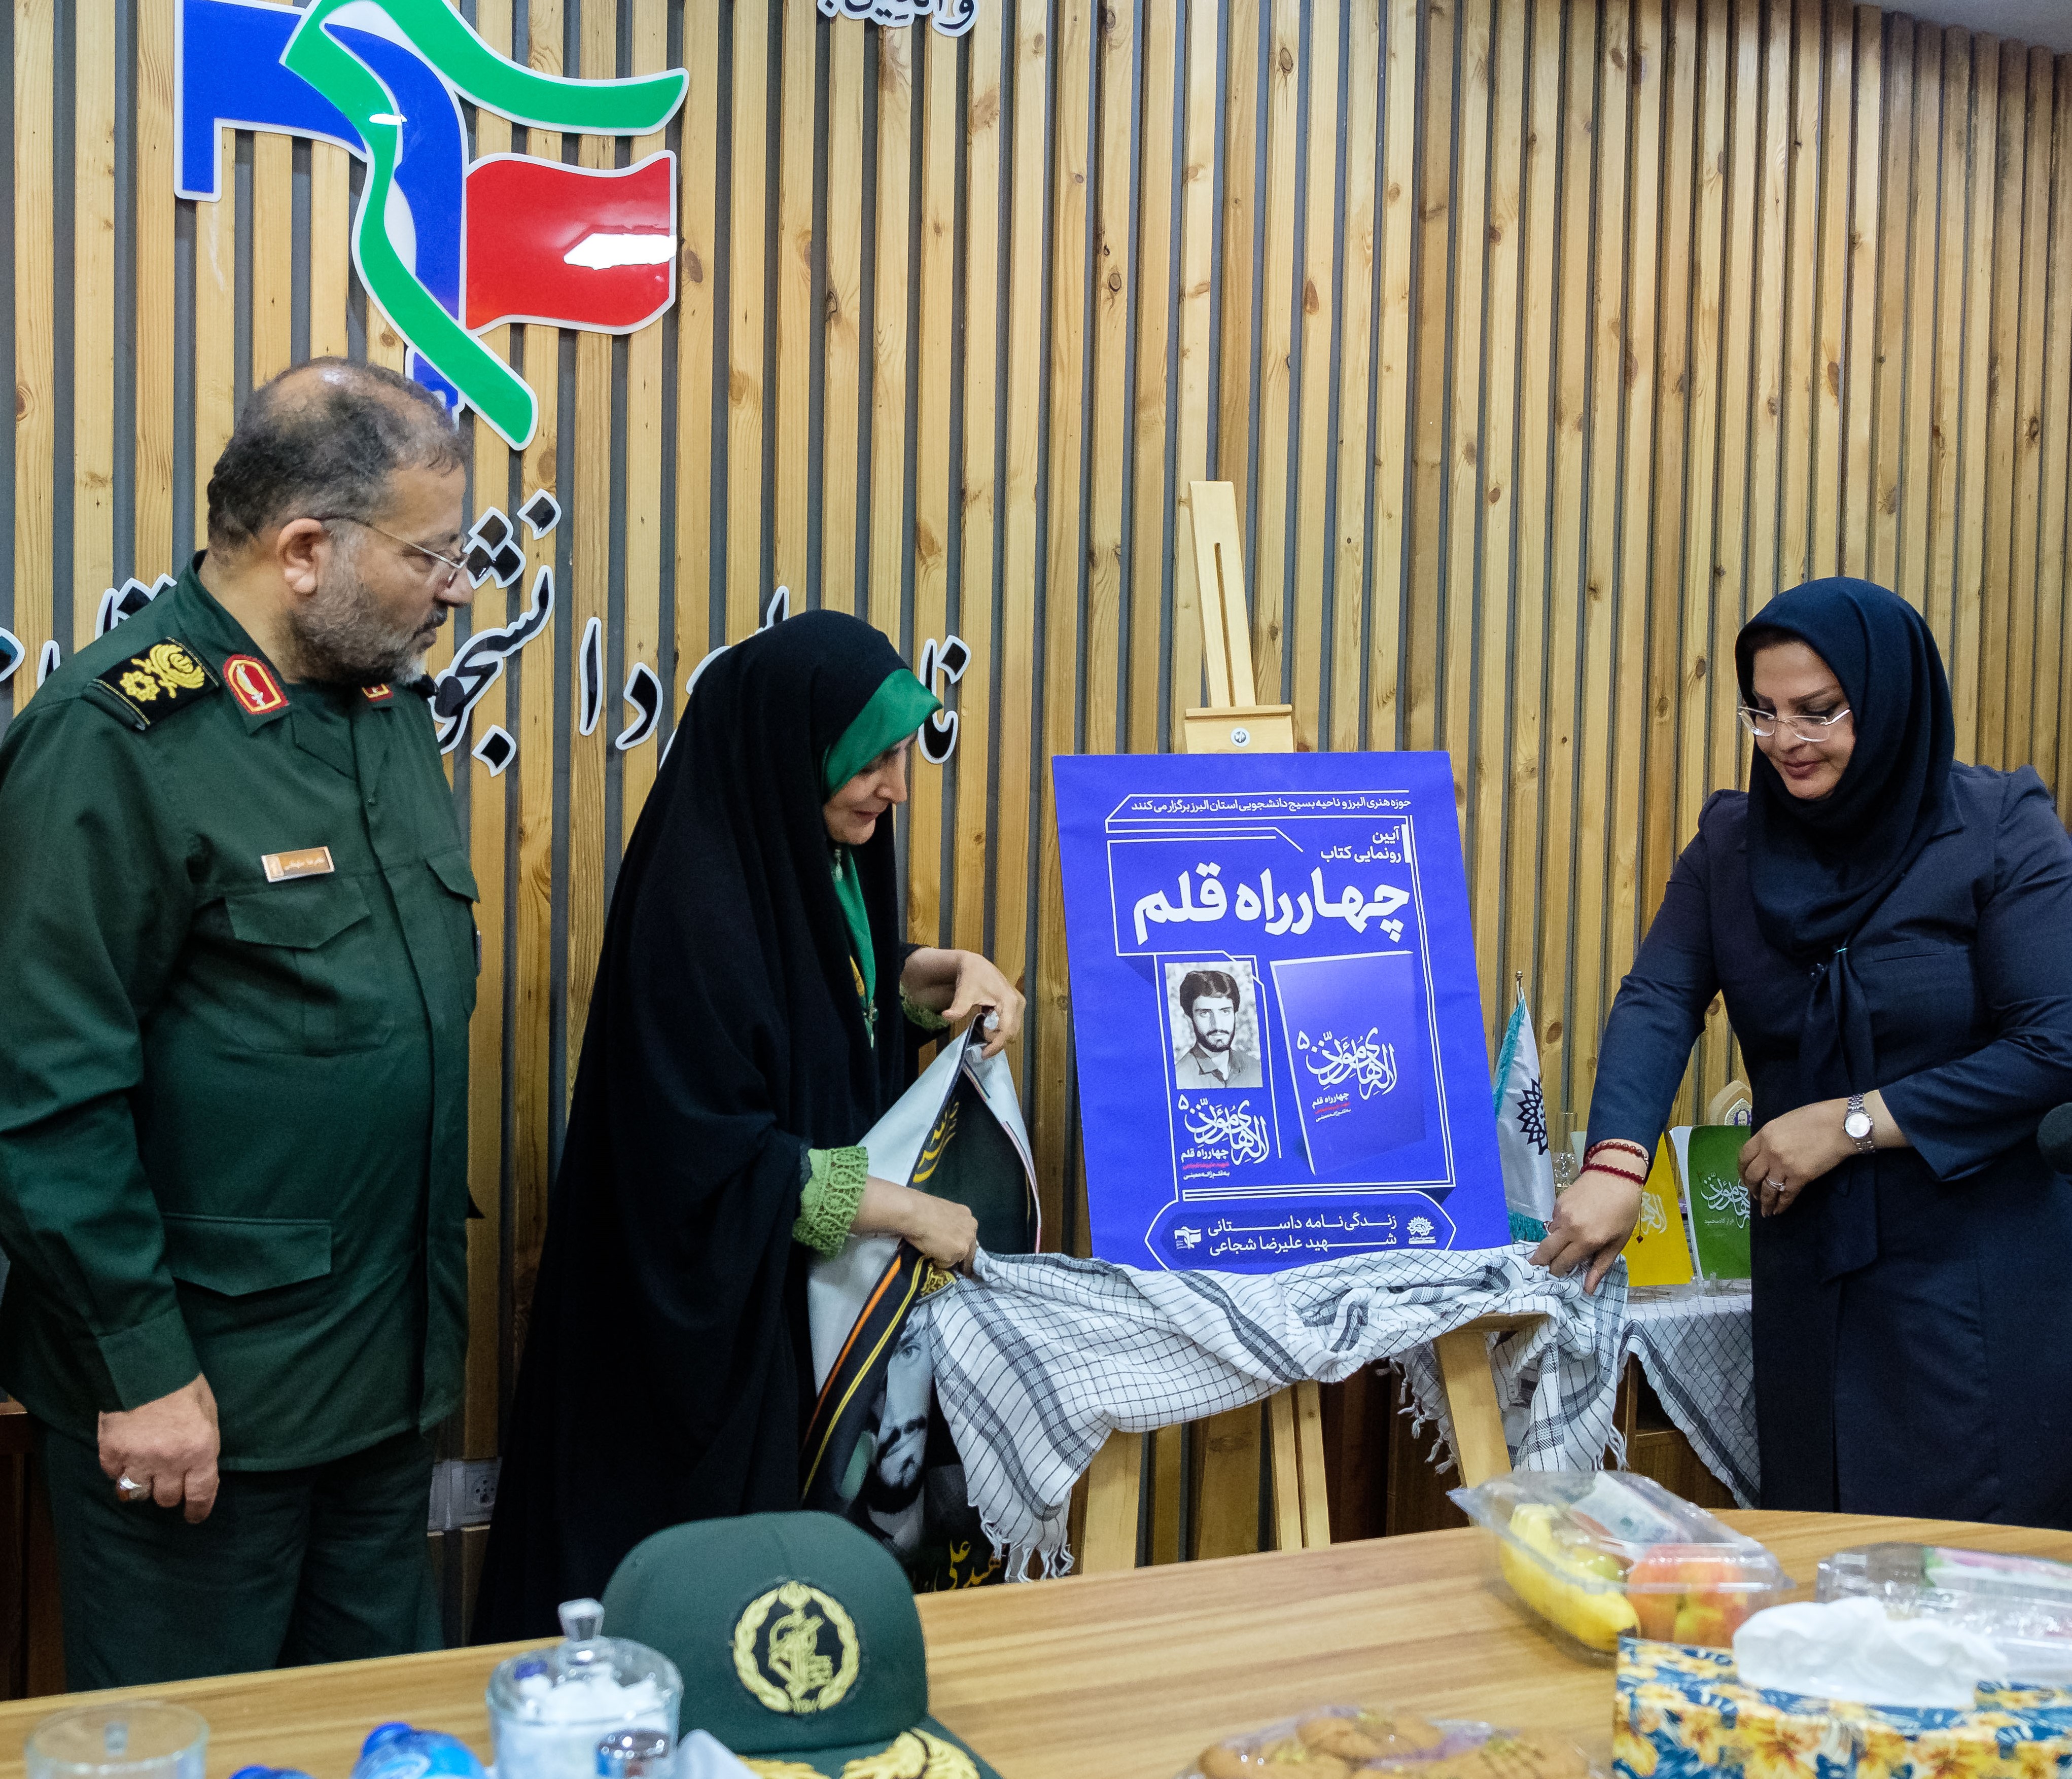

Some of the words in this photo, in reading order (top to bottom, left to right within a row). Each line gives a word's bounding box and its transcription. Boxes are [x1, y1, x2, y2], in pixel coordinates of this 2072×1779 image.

[1167, 799, 1190, 813] برگزار
[1190, 799, 1209, 813] البرز
[1209, 799, 1238, 811] استان
[1238, 798, 1288, 812] دانشجویی
[1289, 800, 1316, 812] بسیج
[1316, 797, 1341, 809] ناحیه
[1347, 797, 1366, 809] البرز
[1366, 798, 1390, 809] هنری
[1390, 799, 1411, 810] حوزه
[1372, 826, 1400, 844] آیین
[1320, 845, 1352, 863] کتاب
[1353, 845, 1401, 863] رونمایی
[1133, 862, 1228, 945] قلم
[1296, 1029, 1310, 1050] ۵
[1178, 1093, 1189, 1110] ۵
[1312, 1096, 1323, 1110] قلم
[1180, 1148, 1195, 1163] قلم
[1210, 1237, 1257, 1256] شجاعی
[1259, 1234, 1303, 1254] علیرضا
[1305, 1232, 1397, 1253] شهید
